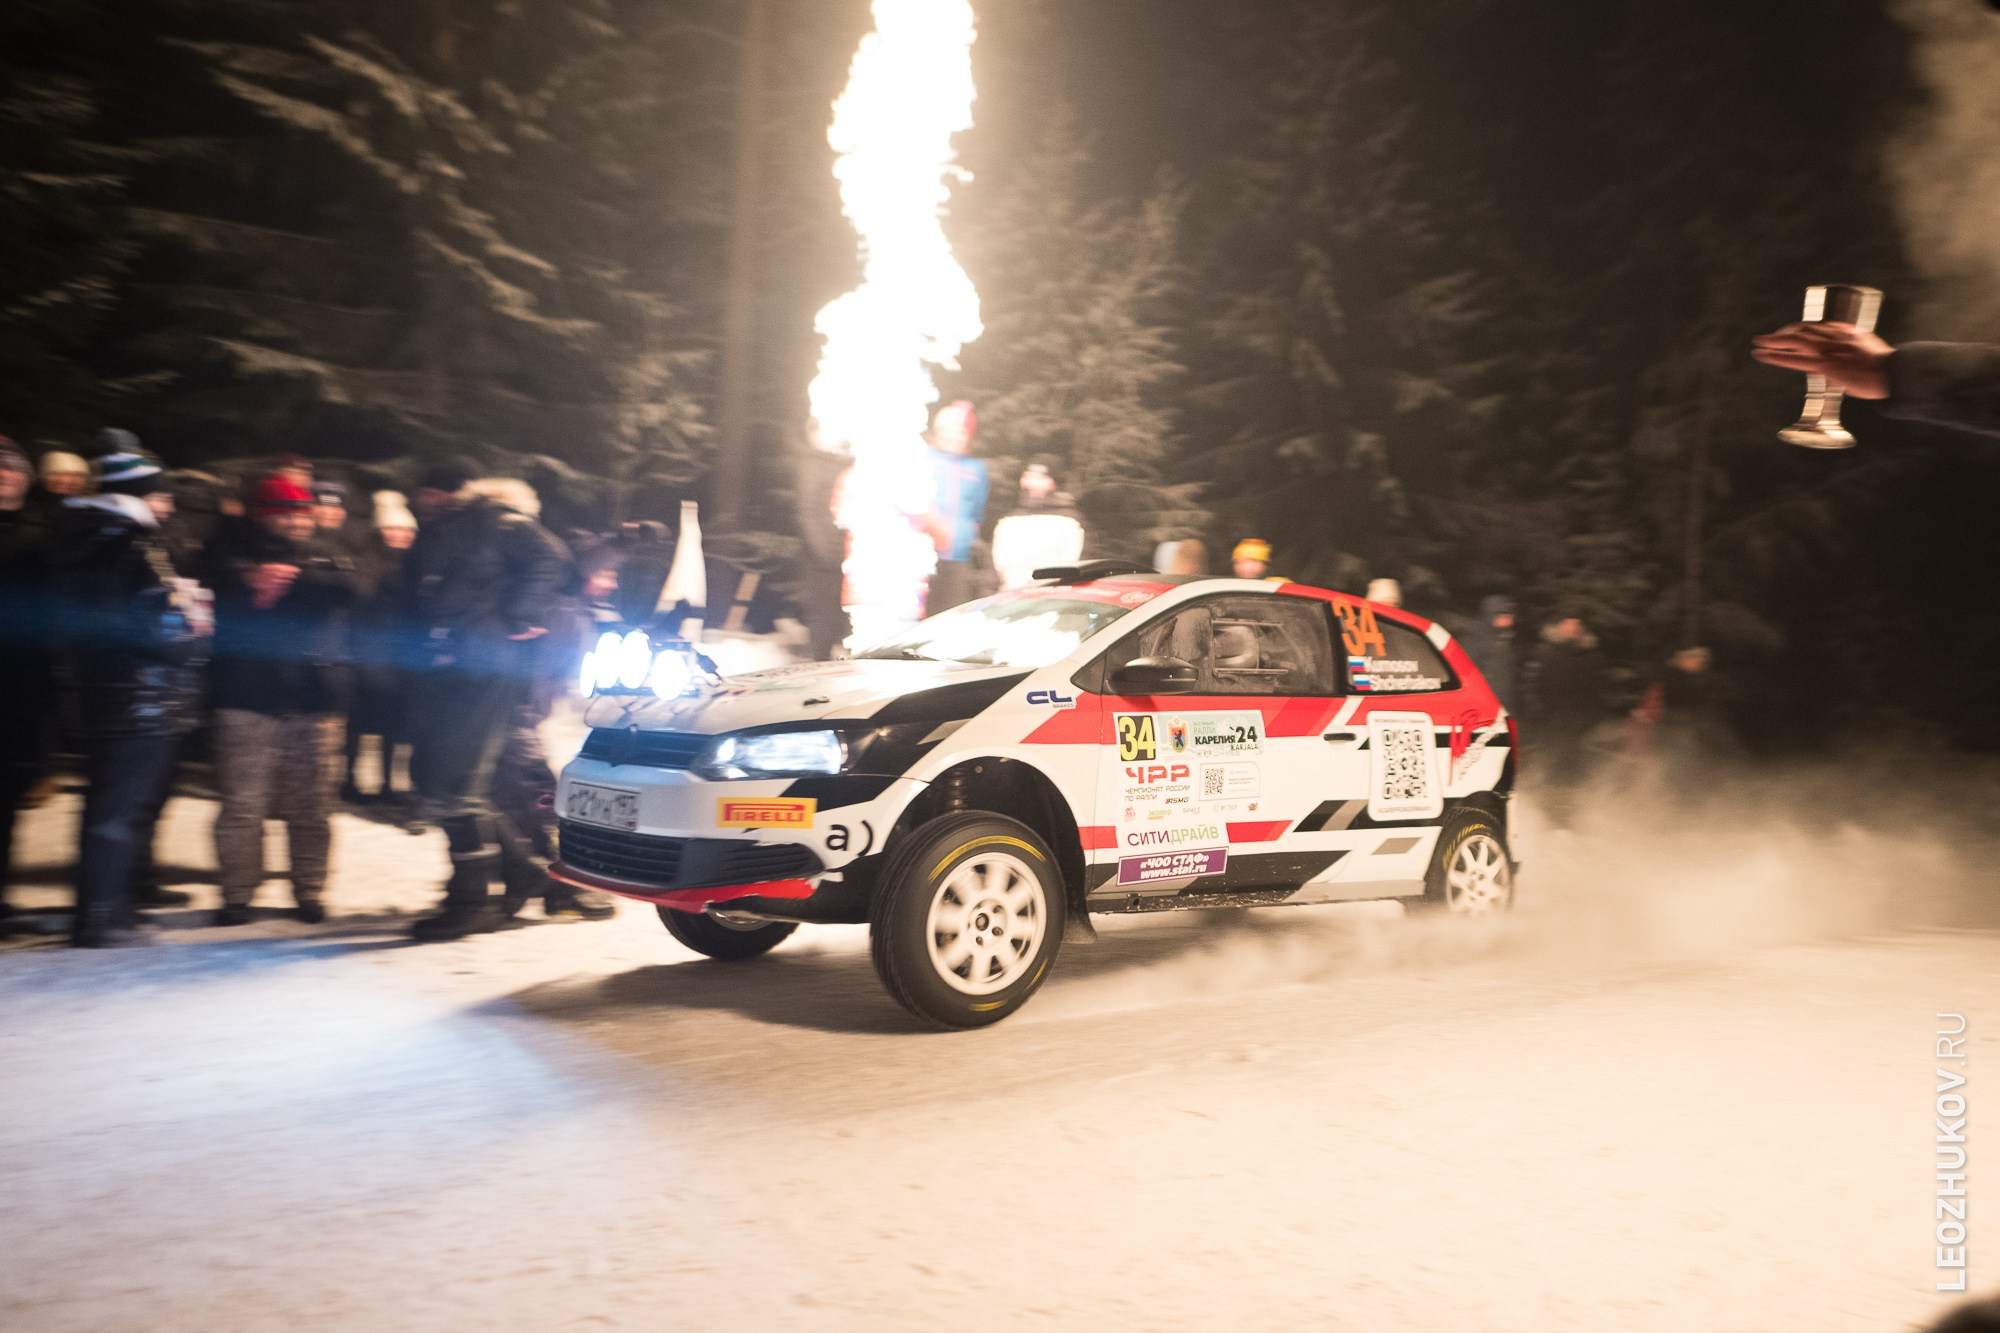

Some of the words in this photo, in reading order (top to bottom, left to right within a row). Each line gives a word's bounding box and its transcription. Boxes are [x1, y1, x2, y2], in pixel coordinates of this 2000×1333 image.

[1331, 596, 1387, 657] 34
[1026, 689, 1073, 705] CL
[1118, 716, 1156, 761] 34
[1193, 727, 1216, 735] РАЛЛИ
[1195, 735, 1236, 745] КАРЕЛИЯ
[1125, 764, 1190, 784] ЧРР
[1125, 786, 1163, 795] ЧЕМПИОНАТ
[722, 803, 806, 823] PIRELLI
[1127, 824, 1219, 847] СИТИДРАЙВ
[1172, 853, 1210, 867] СТАФ»
[1140, 864, 1208, 880] www.staf.ru
